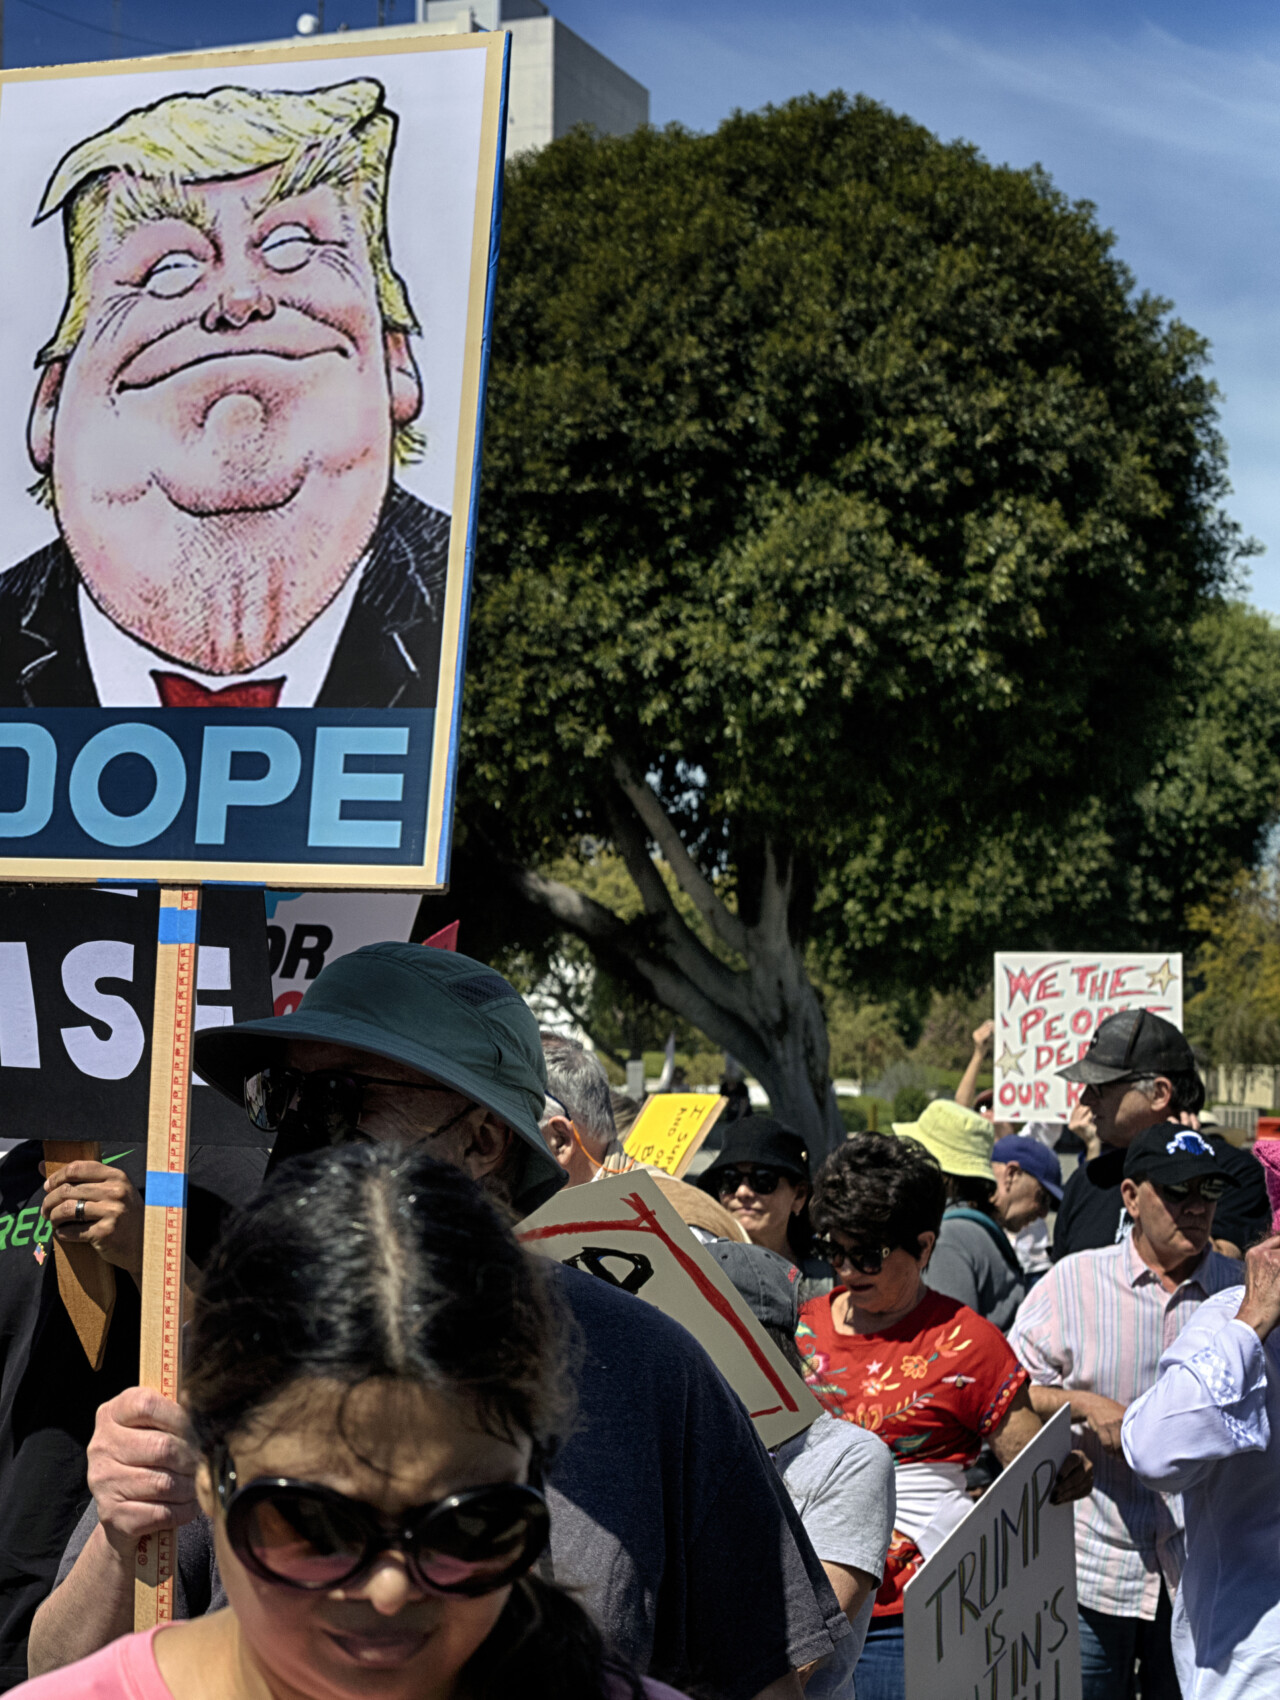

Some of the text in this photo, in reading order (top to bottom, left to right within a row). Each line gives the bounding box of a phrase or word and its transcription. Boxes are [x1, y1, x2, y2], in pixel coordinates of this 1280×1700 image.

[1003, 960, 1157, 1010] WE THE
[998, 1081, 1049, 1110] OUR
[925, 1459, 1057, 1663] TRUMP
[974, 1585, 1069, 1700] TIN'S
[985, 1608, 1006, 1665] IS
